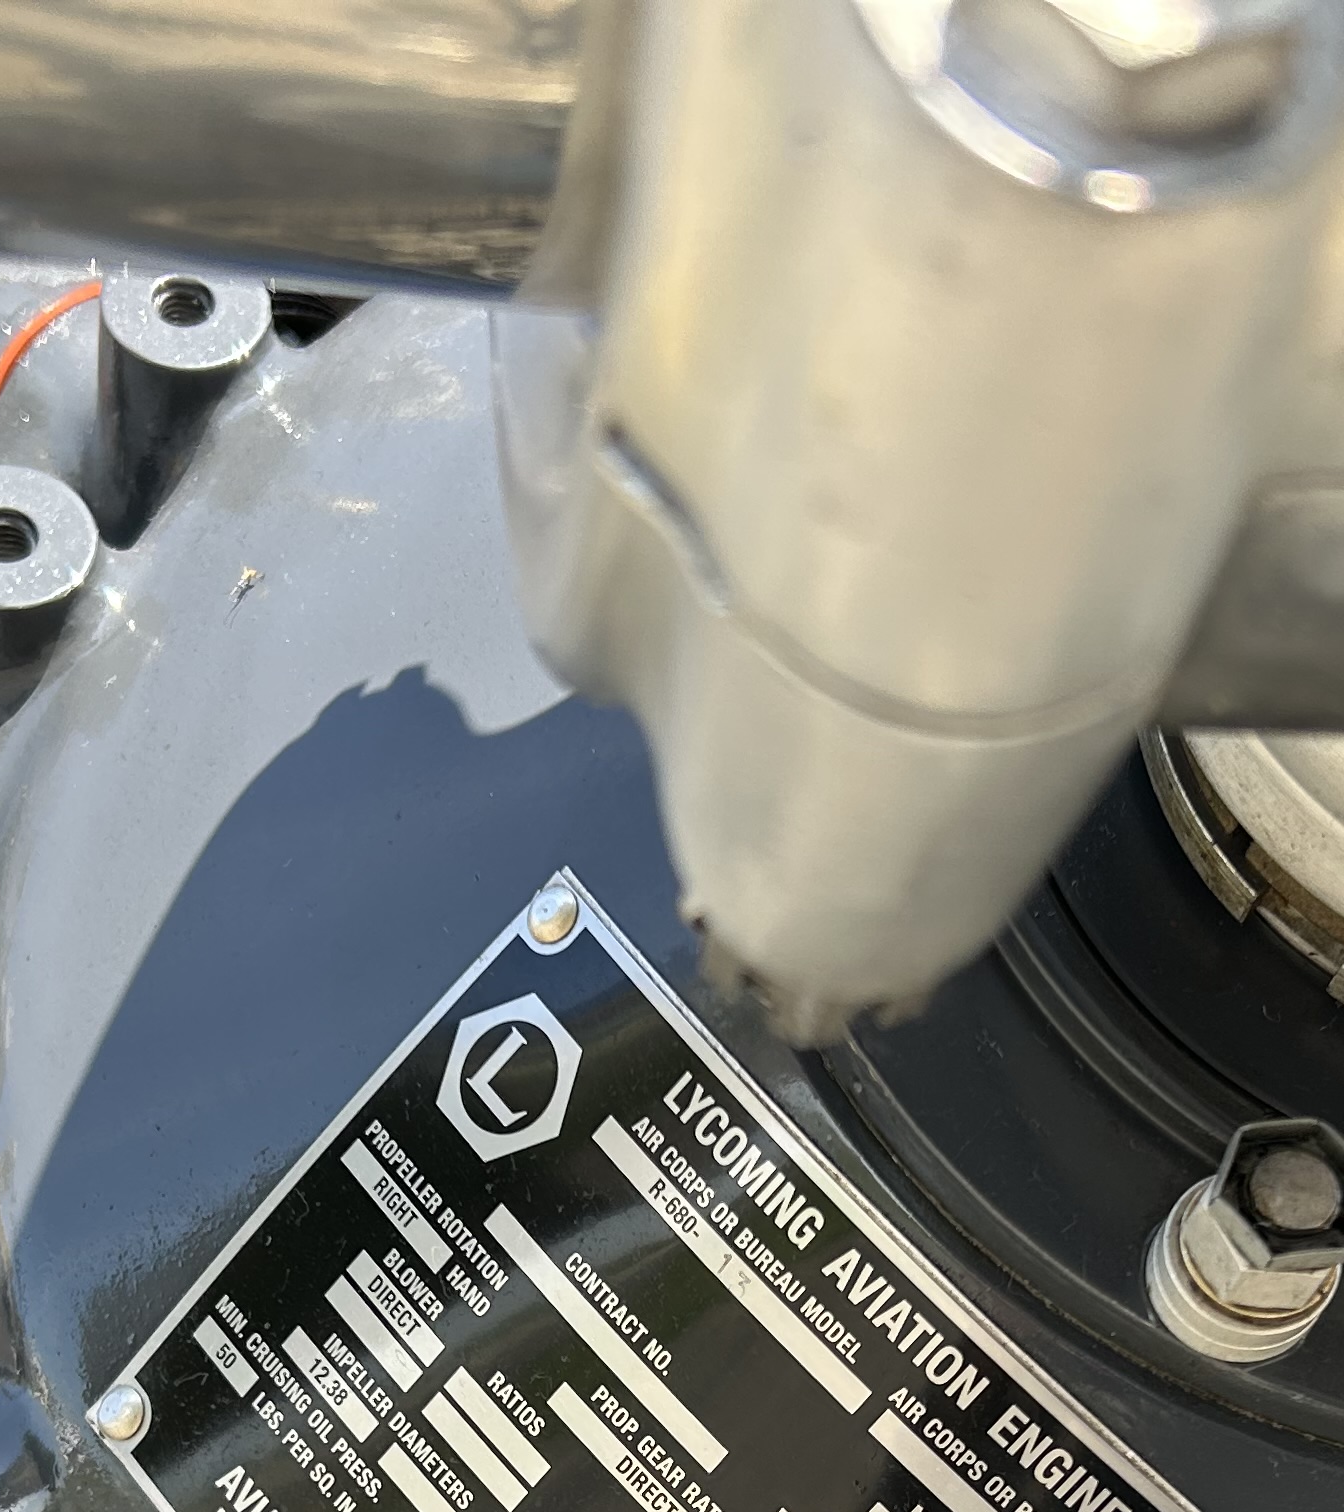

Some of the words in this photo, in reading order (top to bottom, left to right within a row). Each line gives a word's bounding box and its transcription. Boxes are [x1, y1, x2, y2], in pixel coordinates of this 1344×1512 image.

[464, 1025, 528, 1127] L
[364, 1118, 443, 1215] PROPELLER
[436, 1206, 509, 1292] ROTATION
[372, 1175, 419, 1228] RIGHT
[444, 1263, 491, 1317] HAND
[630, 1115, 665, 1154] AIR
[659, 1145, 715, 1208] CORPS
[709, 1200, 739, 1236] OR
[732, 1226, 806, 1303] BUREAU
[798, 1294, 861, 1365] MODEL
[662, 1070, 825, 1251] LYCOMING
[820, 1247, 990, 1411] AVIATION
[366, 1273, 422, 1336] DIRECT
[382, 1246, 444, 1322] BLOWER
[564, 1251, 649, 1343] CONTRACT
[641, 1337, 672, 1377] NO.
[214, 1293, 248, 1339] MIN.
[245, 1331, 312, 1415] CRUISING
[306, 1408, 334, 1444] OIL
[329, 1436, 382, 1504] PRESS.
[214, 1342, 237, 1369] 50
[250, 1390, 284, 1436] LBS.
[280, 1427, 314, 1469] PER
[308, 1461, 335, 1498] SQ.
[308, 1357, 348, 1406] 12.38
[322, 1331, 394, 1418] IMPELLER
[386, 1410, 474, 1510] DIAMETERS
[485, 1369, 546, 1437] RATIOS
[589, 1383, 640, 1441] PROP.
[636, 1434, 686, 1489] GEAR
[886, 1386, 927, 1425] AIR
[922, 1417, 988, 1481] CORPS
[983, 1475, 1016, 1508] OR
